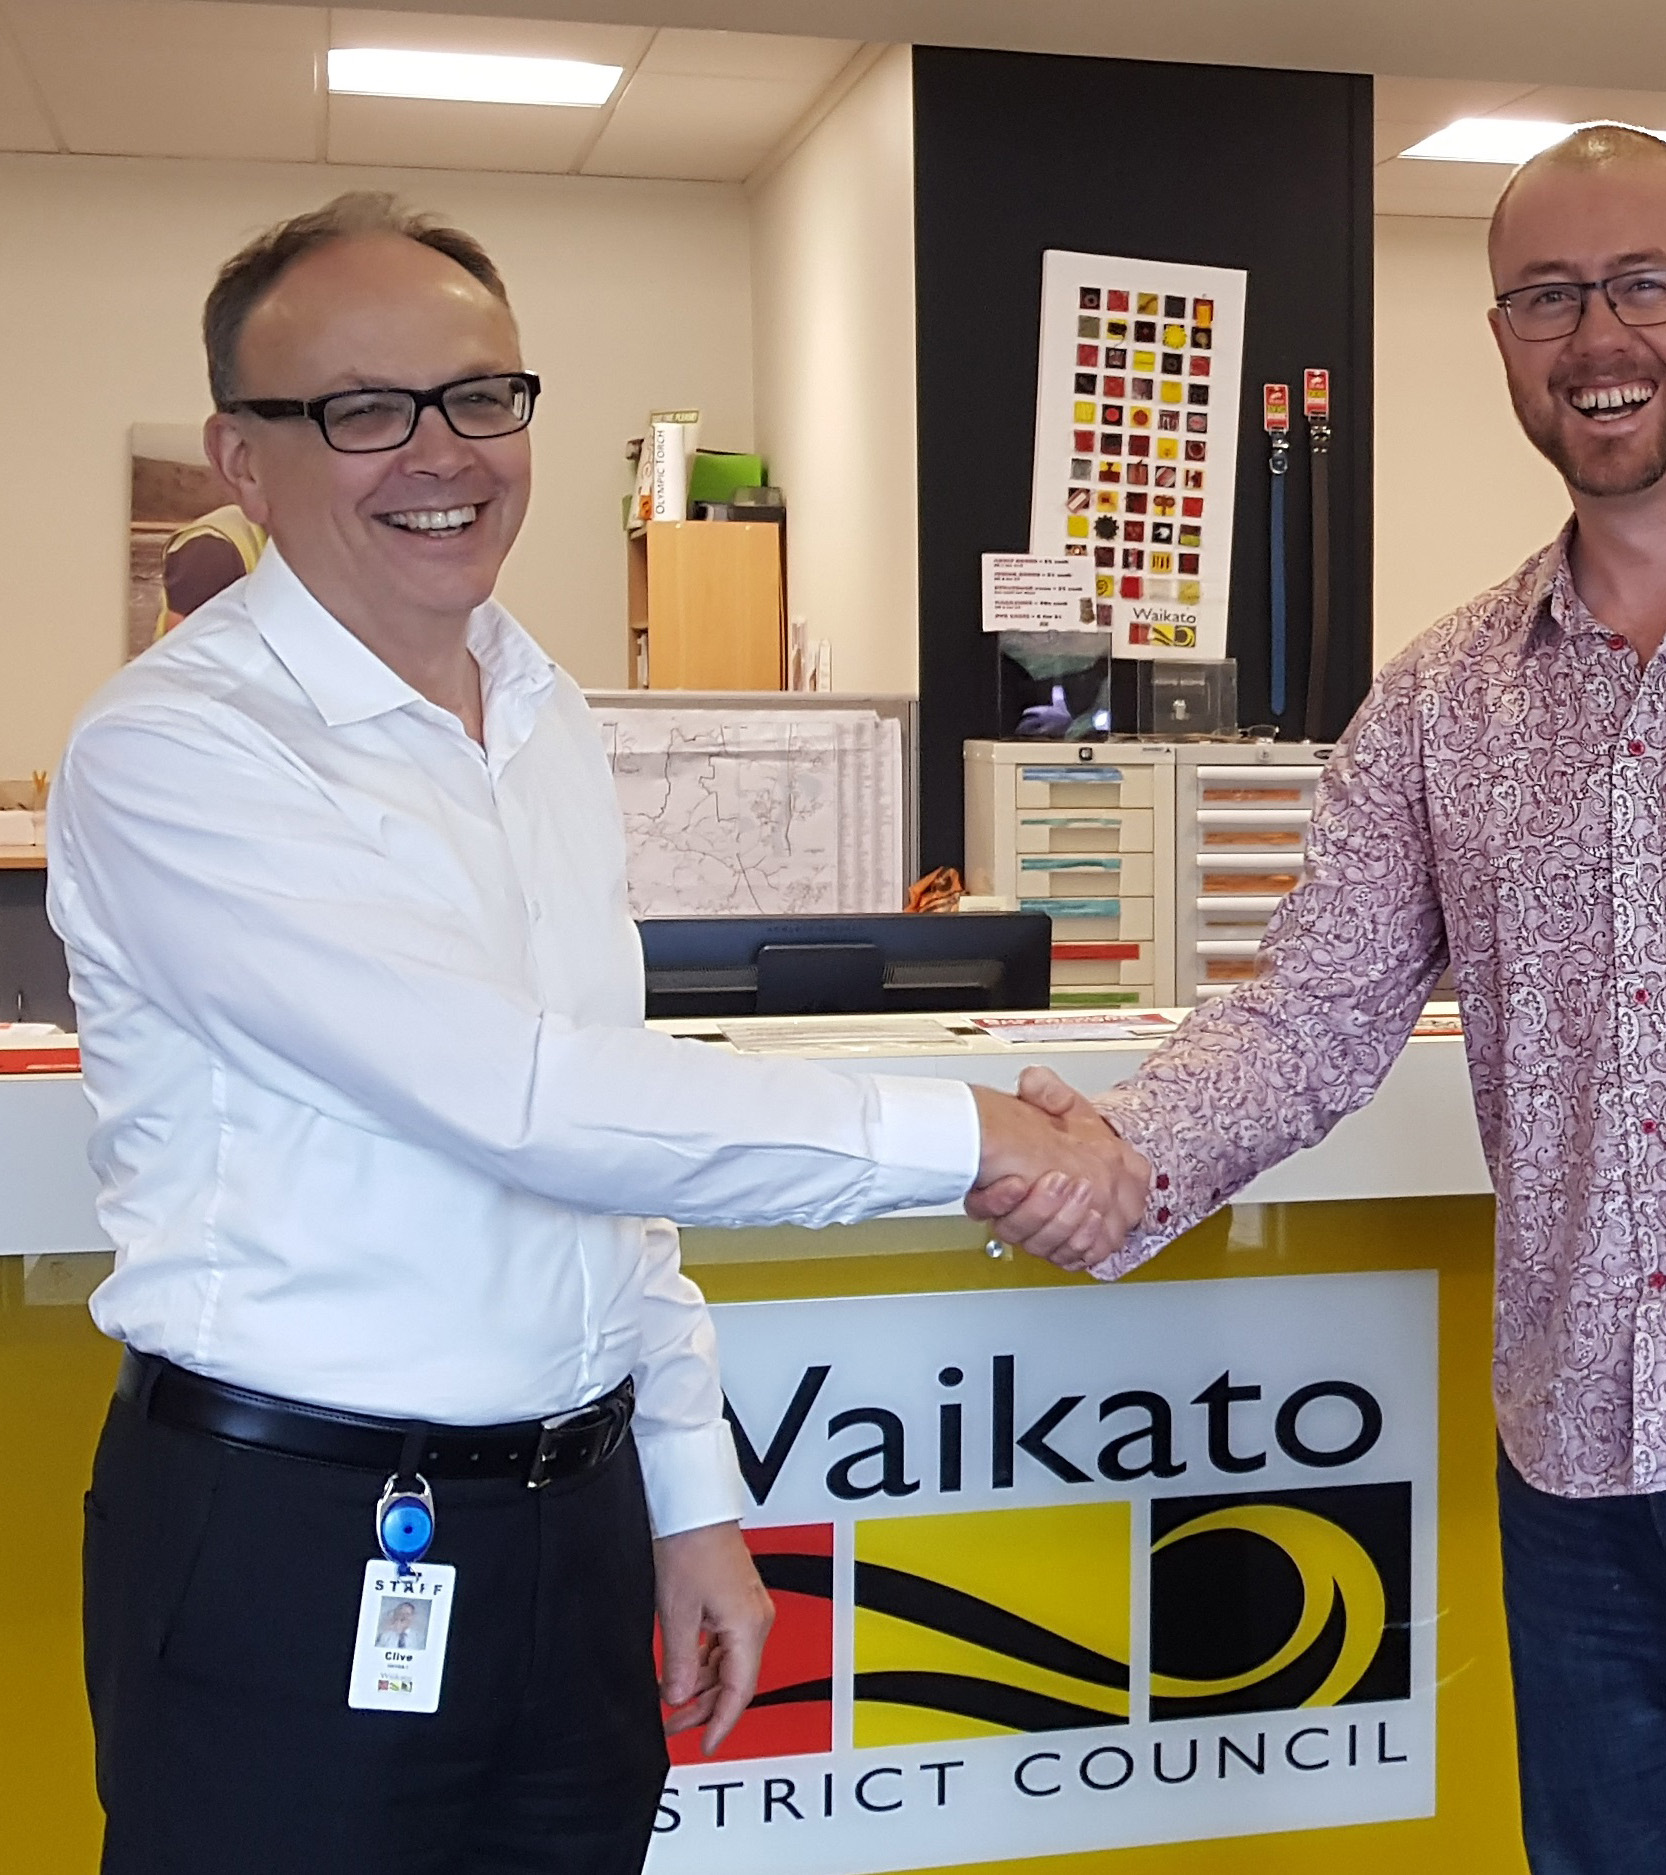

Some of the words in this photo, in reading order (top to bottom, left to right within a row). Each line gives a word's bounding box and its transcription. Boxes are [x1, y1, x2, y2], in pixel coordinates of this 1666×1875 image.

[656, 430, 665, 463] TORCH
[656, 469, 665, 514] OLYMPIC
[1133, 607, 1197, 623] Waikato
[375, 1579, 443, 1596] STAFF
[385, 1651, 413, 1662] Clive
[651, 1761, 964, 1834] STRICT
[1013, 1721, 1409, 1798] COUNCIL
